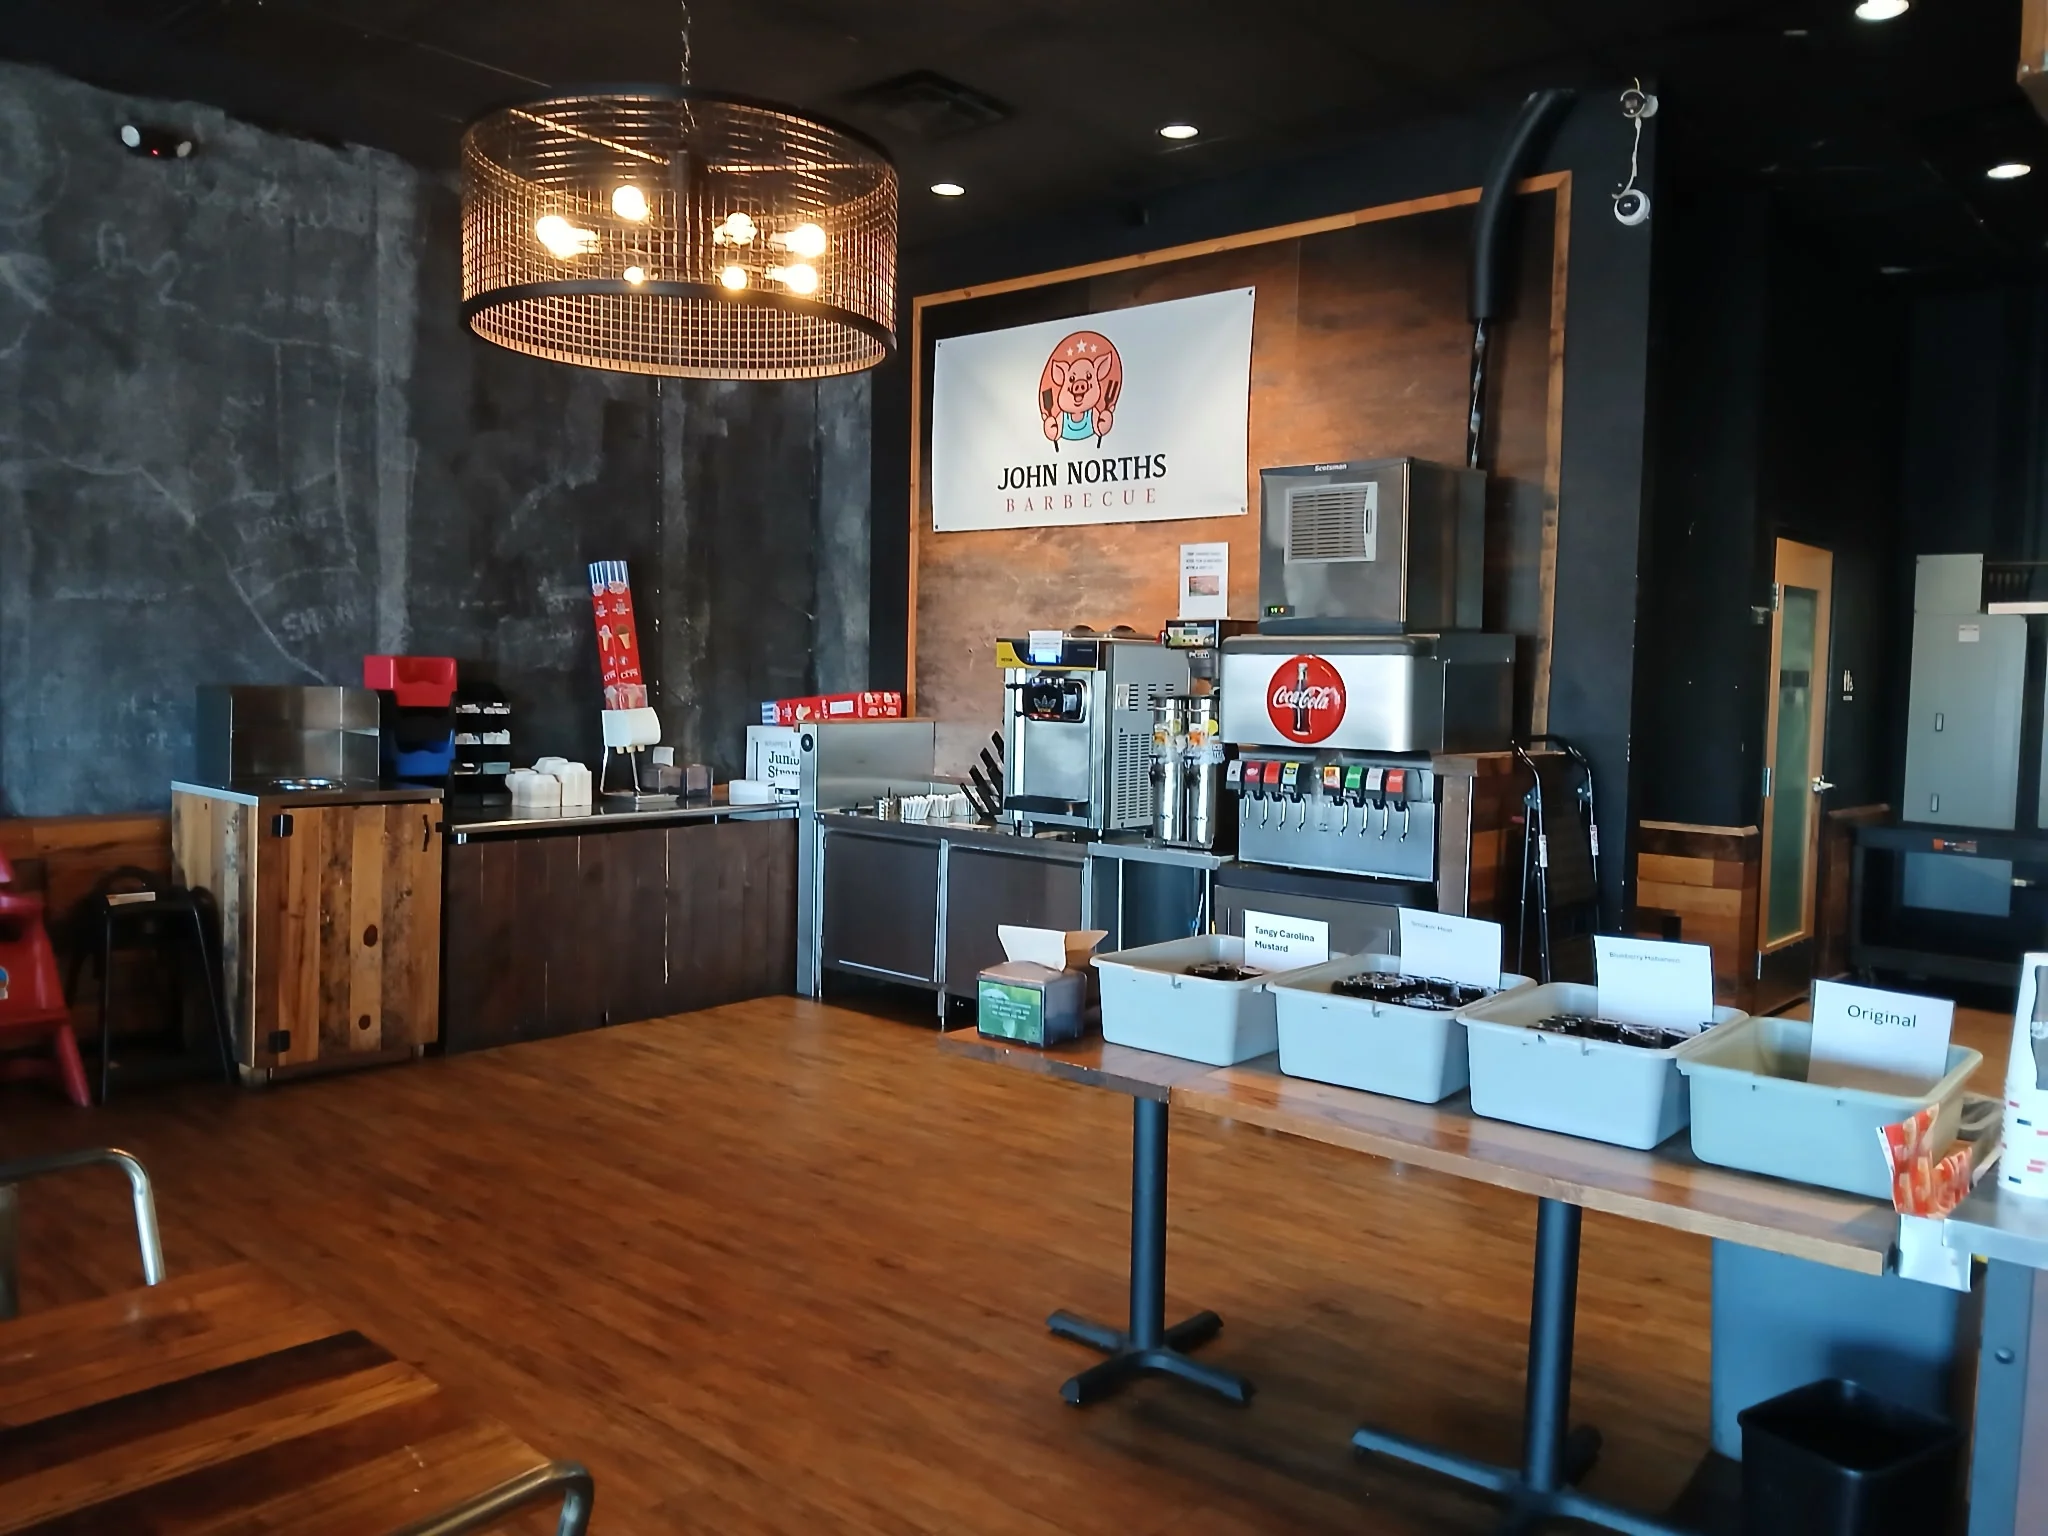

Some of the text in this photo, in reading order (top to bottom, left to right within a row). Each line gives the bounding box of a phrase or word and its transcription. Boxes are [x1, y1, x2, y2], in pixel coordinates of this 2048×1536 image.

[998, 453, 1167, 490] JOHN NORTHS
[1314, 463, 1347, 472] Scotsman
[1006, 487, 1156, 513] BARBECUE
[1272, 685, 1331, 710] Coca-Cola
[1255, 925, 1315, 942] Tangy Carolina
[1254, 940, 1289, 953] Mustard
[1847, 1004, 1917, 1028] Original
